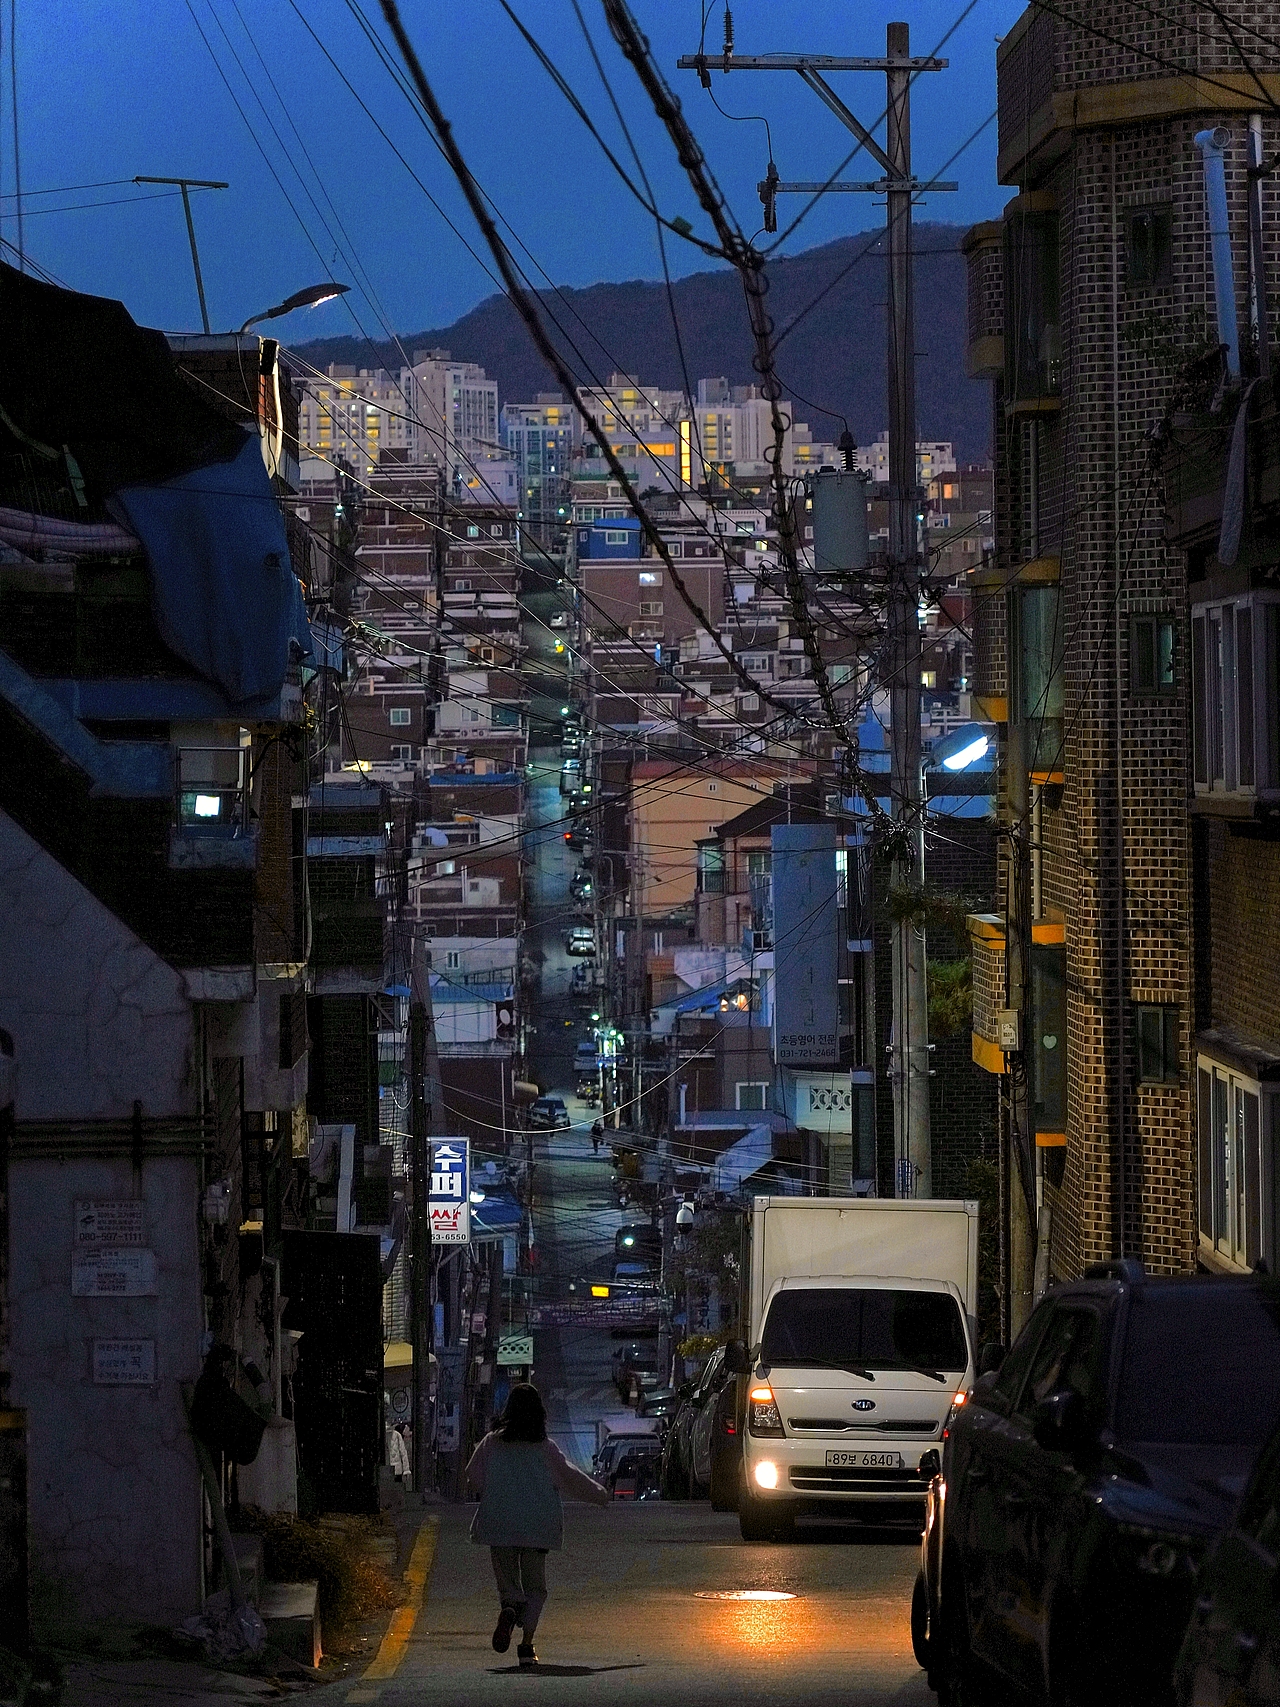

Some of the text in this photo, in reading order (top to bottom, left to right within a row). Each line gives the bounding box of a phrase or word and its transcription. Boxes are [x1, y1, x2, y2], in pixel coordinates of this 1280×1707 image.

[780, 1034, 836, 1046] 초등영어 전문
[780, 1049, 836, 1058] 031-721-2468
[430, 1145, 463, 1197] 수퍼
[431, 1209, 461, 1231] 쌀
[855, 1401, 873, 1410] KIA
[832, 1453, 893, 1466] 89보 6840
